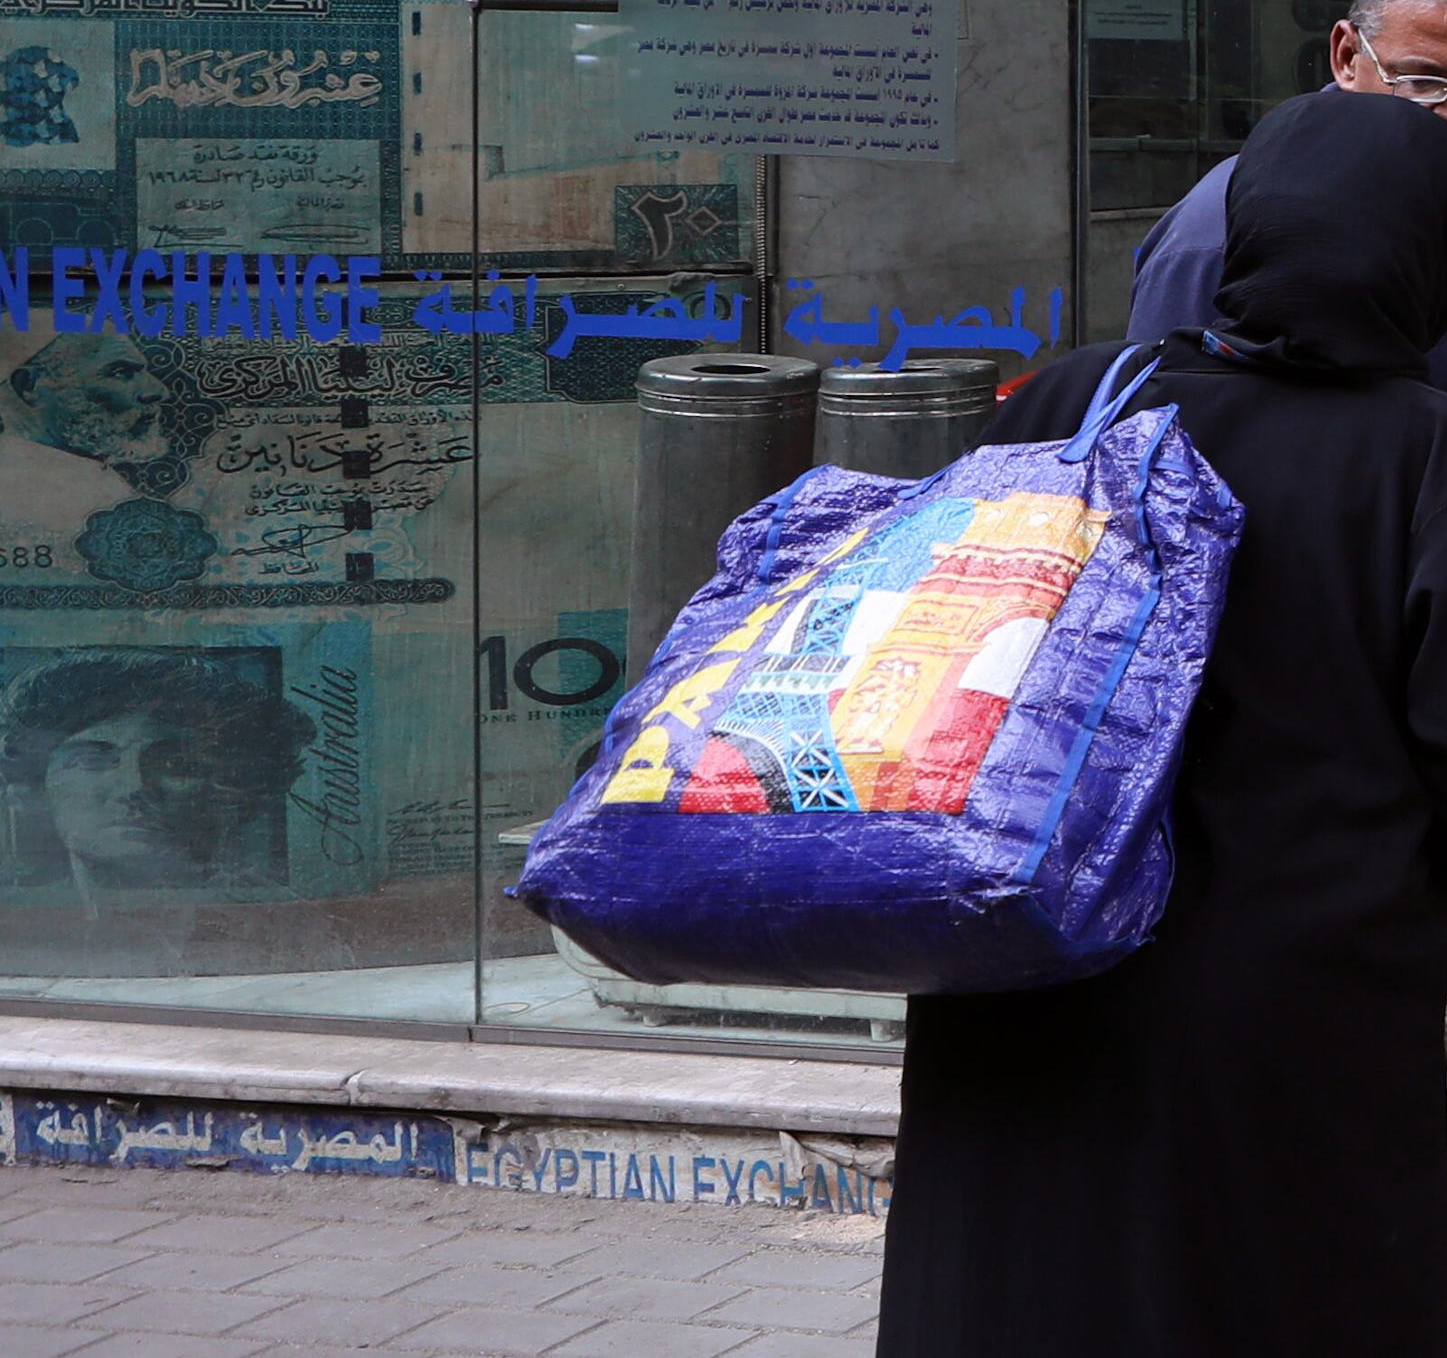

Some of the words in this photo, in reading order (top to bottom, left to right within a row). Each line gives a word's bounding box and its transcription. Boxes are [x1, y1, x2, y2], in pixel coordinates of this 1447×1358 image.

[630, 191, 722, 260] ٢٠
[52, 247, 381, 343] EXCHANGE
[412, 270, 747, 359] للصرافة
[783, 278, 1063, 372] المصرية
[478, 635, 627, 711] 10
[528, 707, 612, 721] HUNDRE
[36, 1100, 216, 1163] للصرافة
[239, 1112, 419, 1174] المصرية
[466, 1142, 677, 1204] EGYPTIAN
